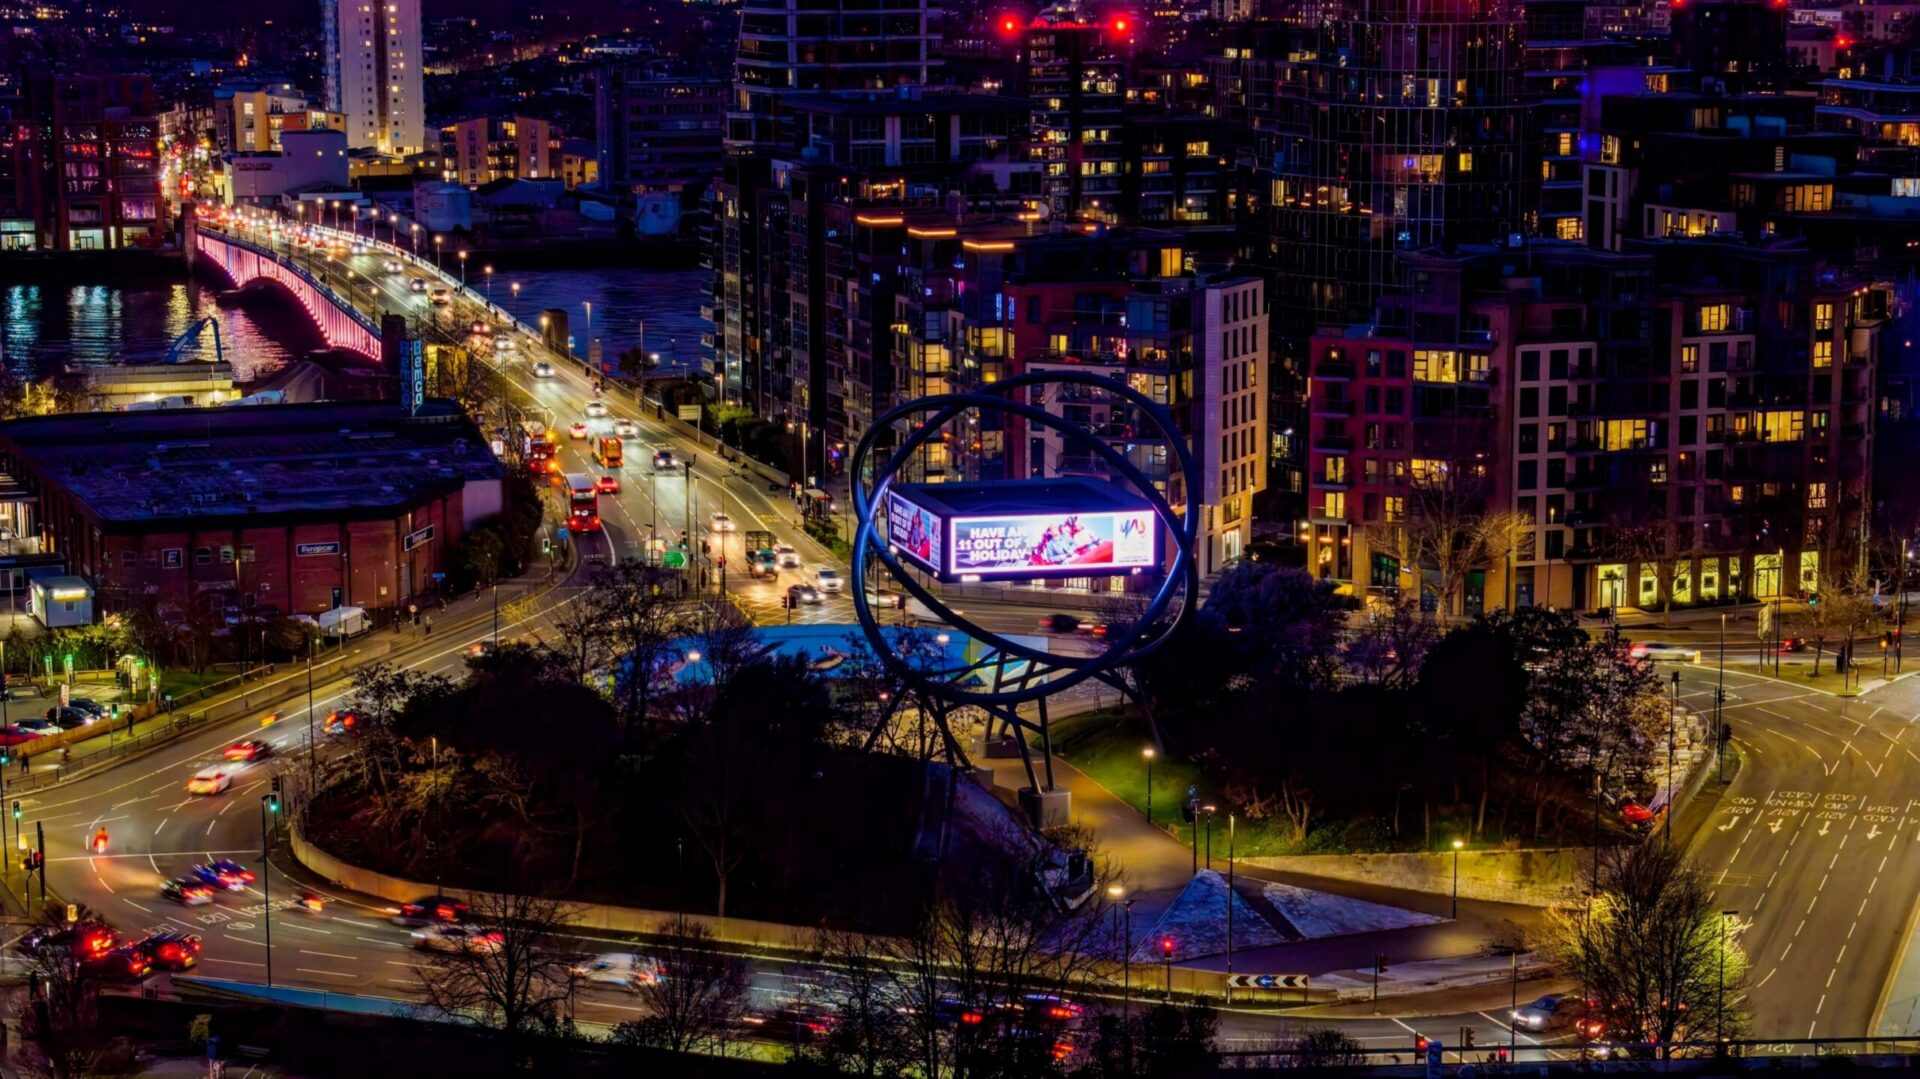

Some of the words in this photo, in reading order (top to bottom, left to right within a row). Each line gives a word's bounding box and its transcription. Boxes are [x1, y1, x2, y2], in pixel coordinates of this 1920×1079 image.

[970, 527, 1005, 539] HAVE
[1007, 526, 1028, 537] AN
[959, 540, 971, 550] 11
[974, 539, 1002, 550] OUT
[1004, 538, 1021, 549] OF
[301, 545, 335, 553] Europcar
[970, 549, 1026, 562] HOLIDAY
[1721, 806, 1754, 814] A217
[1767, 808, 1800, 816] A217
[1815, 811, 1848, 820] A217
